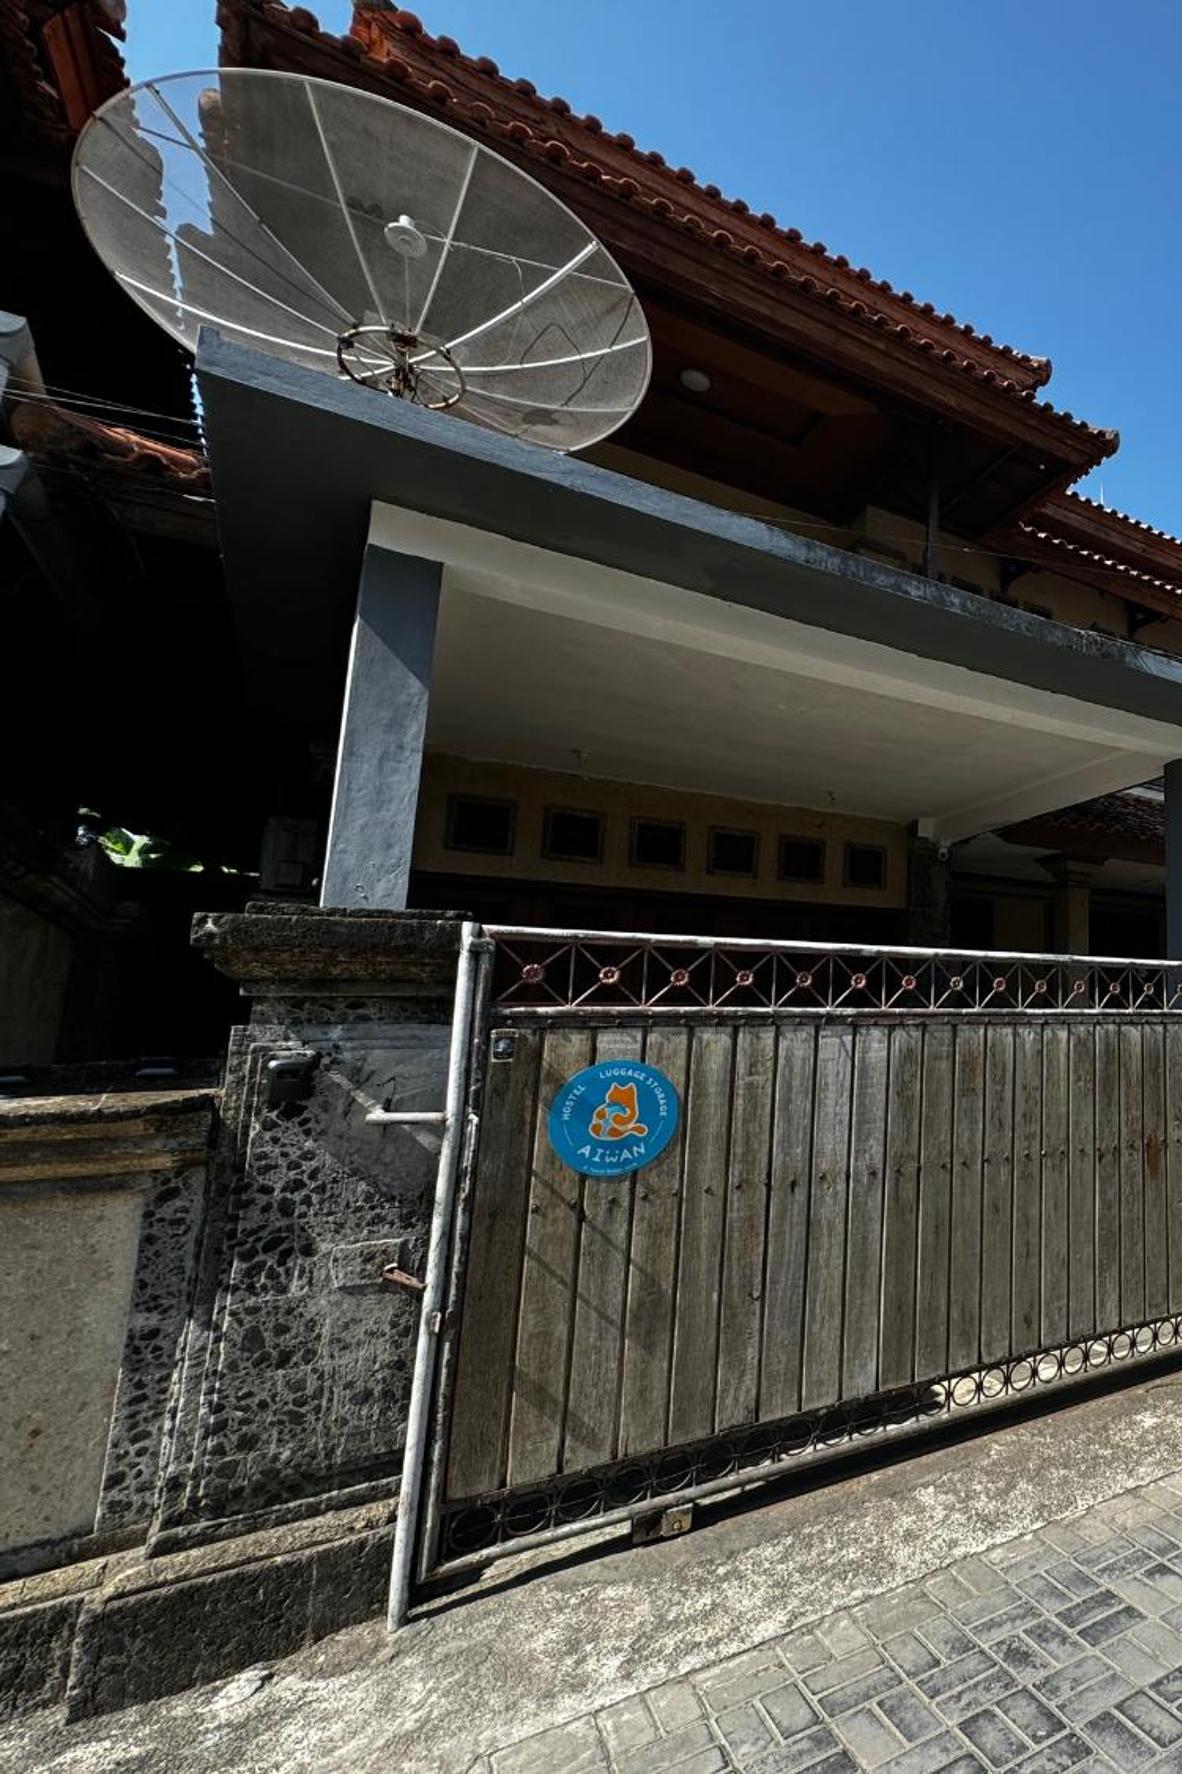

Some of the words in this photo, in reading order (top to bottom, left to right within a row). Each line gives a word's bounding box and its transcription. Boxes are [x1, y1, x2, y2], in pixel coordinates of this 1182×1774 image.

[562, 1084, 586, 1120] HOSTEL
[600, 1068, 646, 1080] LUGGAGE
[646, 1077, 667, 1116] STORAGE
